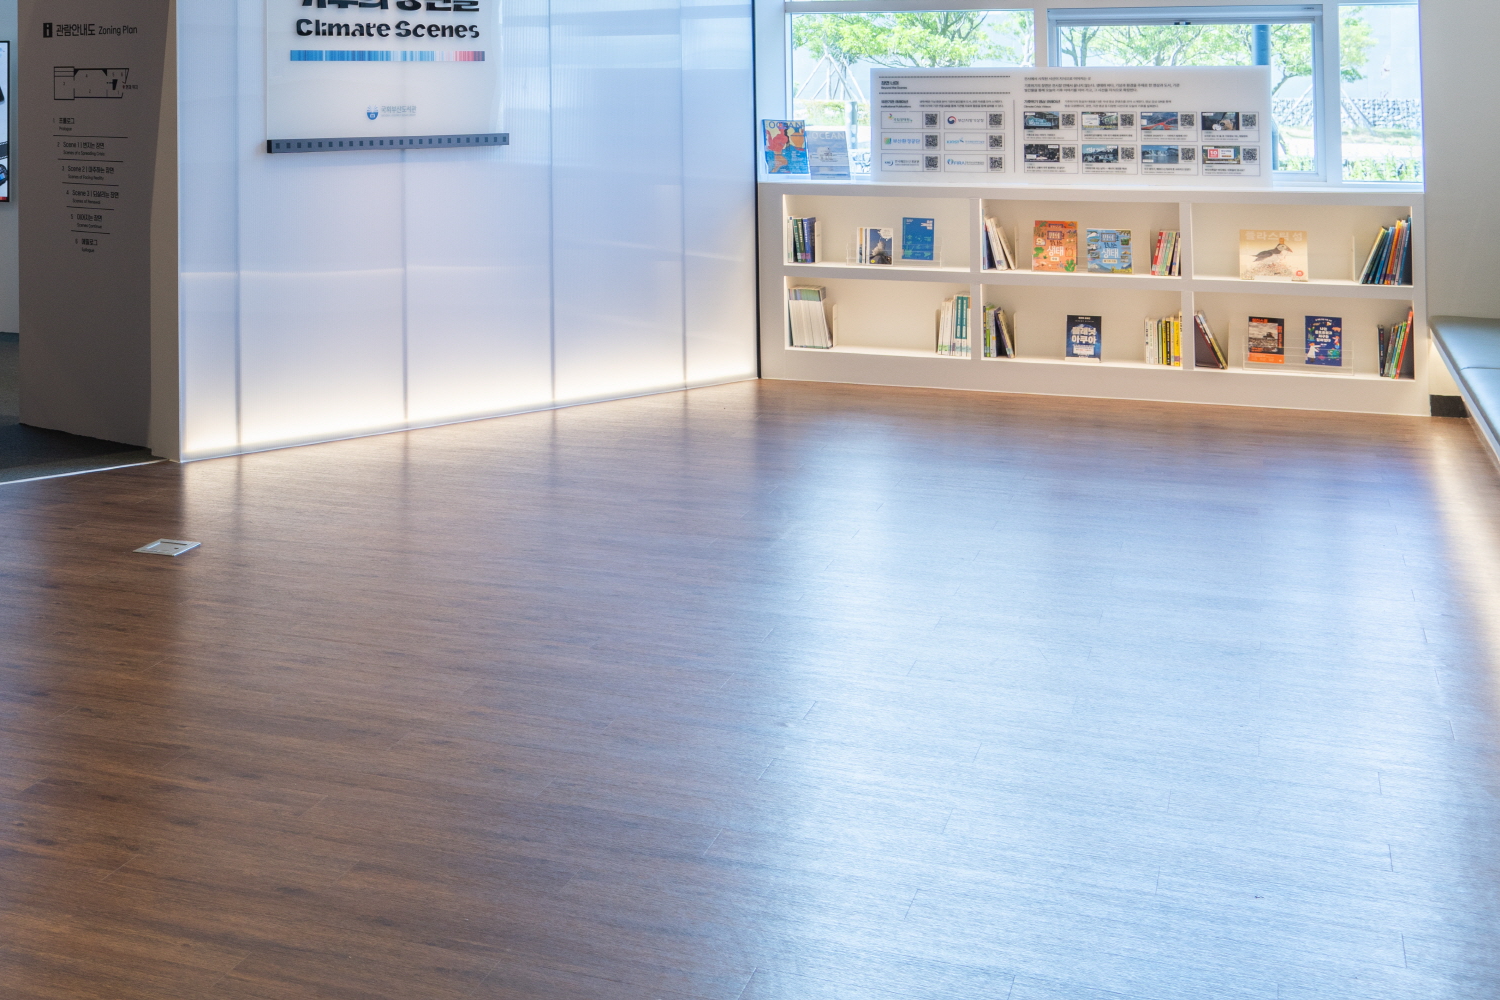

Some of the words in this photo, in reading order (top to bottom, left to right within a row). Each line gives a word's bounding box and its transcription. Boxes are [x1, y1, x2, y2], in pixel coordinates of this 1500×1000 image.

[56, 24, 95, 36] 관람안내도
[98, 25, 121, 36] Zoning
[122, 25, 138, 34] Plan
[296, 18, 390, 37] Climate
[395, 20, 480, 39] Scenes
[768, 121, 804, 129] OCEAN
[811, 132, 845, 140] OCEAN
[1245, 231, 1289, 241] 플라스틱
[1292, 232, 1302, 241] 섬
[1047, 246, 1064, 256] 생태
[1101, 248, 1119, 258] 생태
[1071, 335, 1096, 344] 아쿠아
